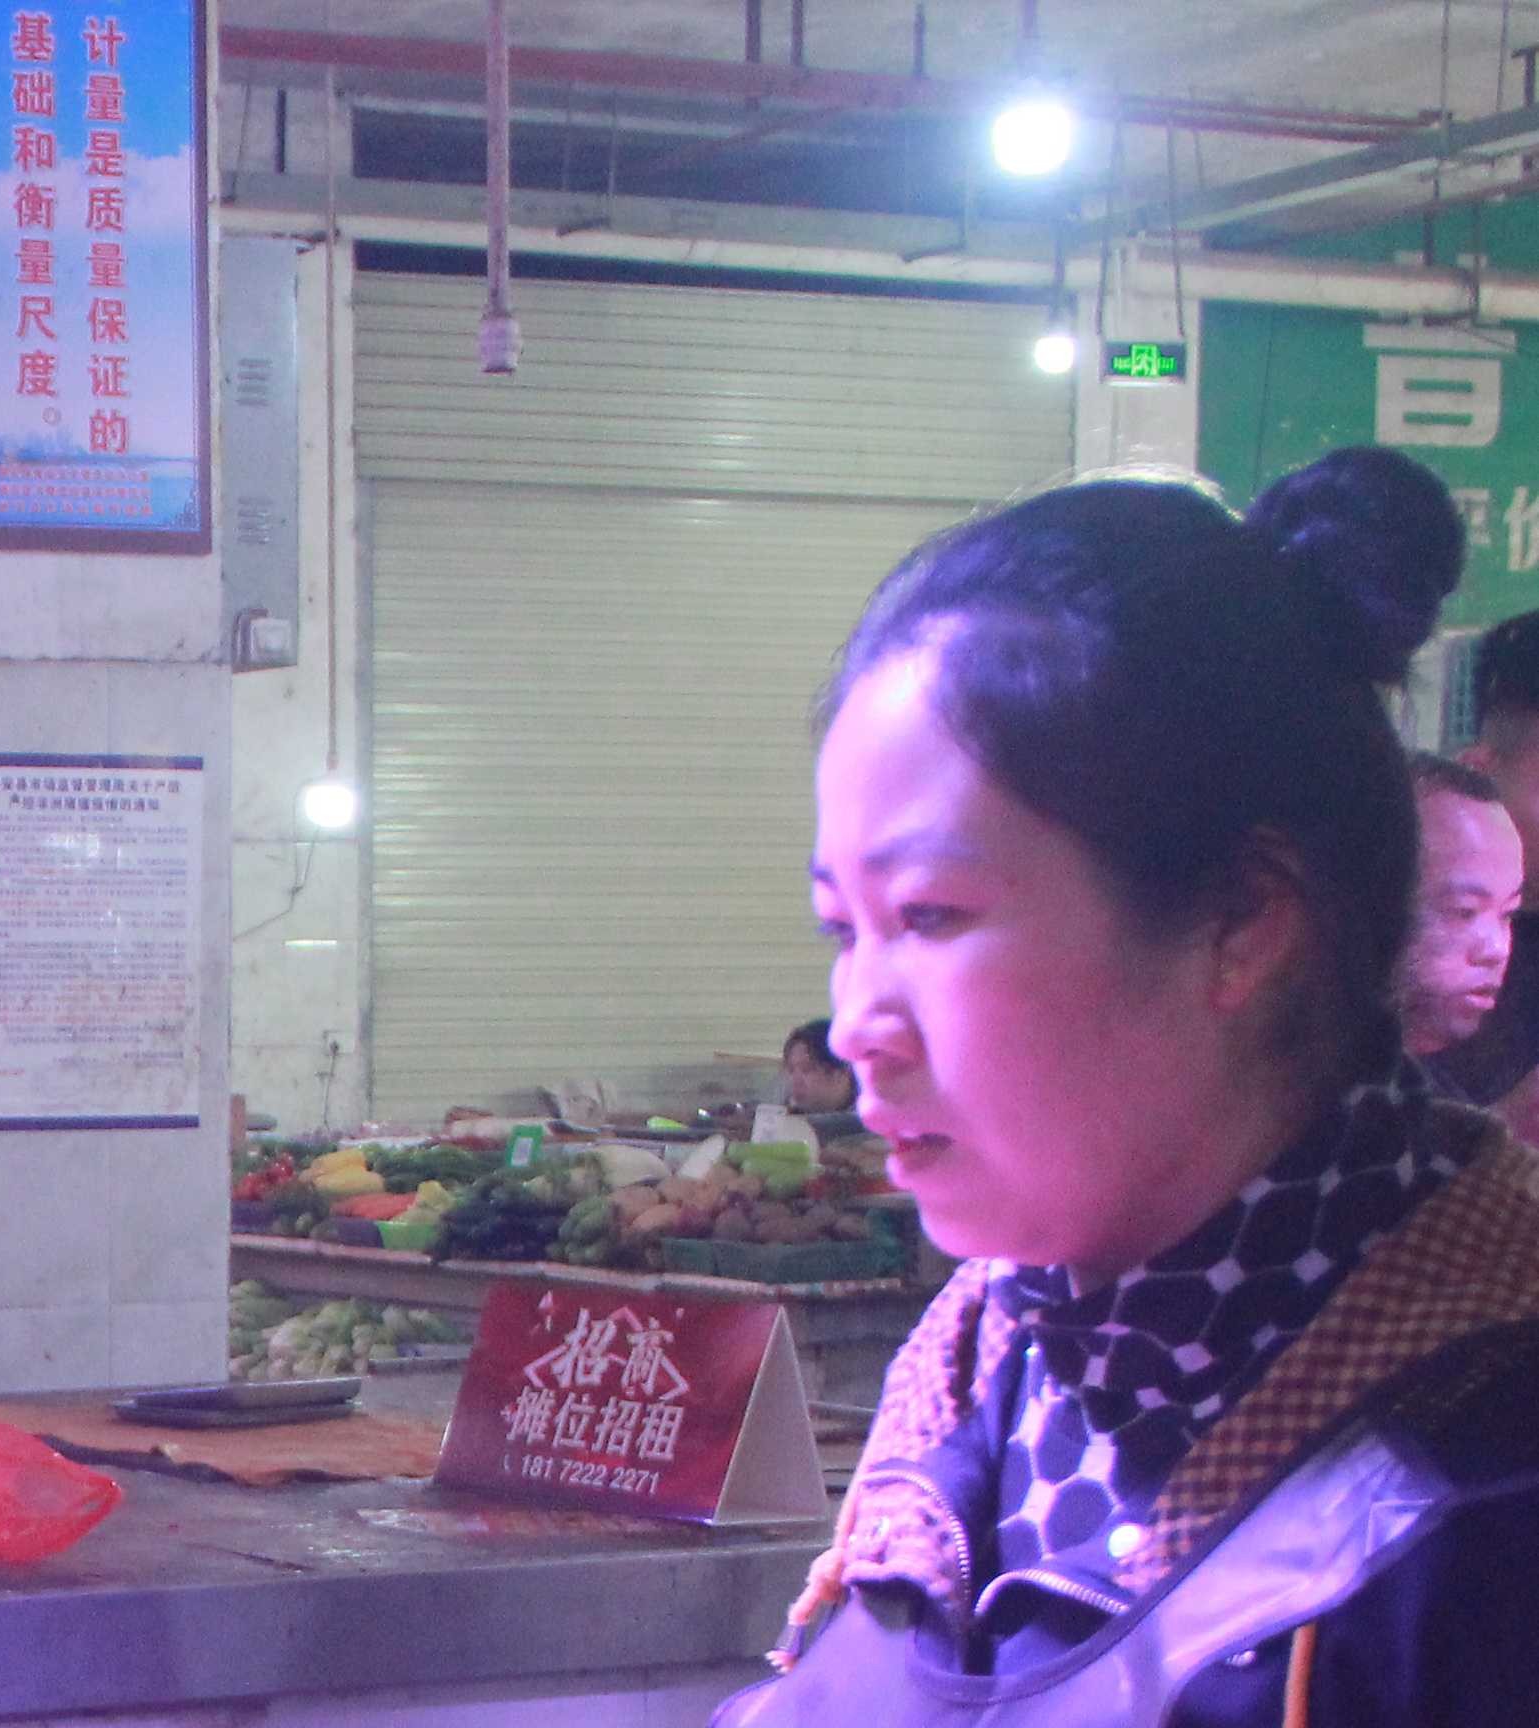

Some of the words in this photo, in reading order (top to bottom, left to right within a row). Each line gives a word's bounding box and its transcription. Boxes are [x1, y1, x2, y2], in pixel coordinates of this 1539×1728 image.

[81, 15, 130, 456] 计量是质量保证的
[551, 1307, 675, 1396] 招商
[500, 1386, 685, 1461] 摊位招租
[521, 1454, 554, 1481] 181
[559, 1458, 609, 1488] 7222
[608, 1466, 660, 1496] 2271
